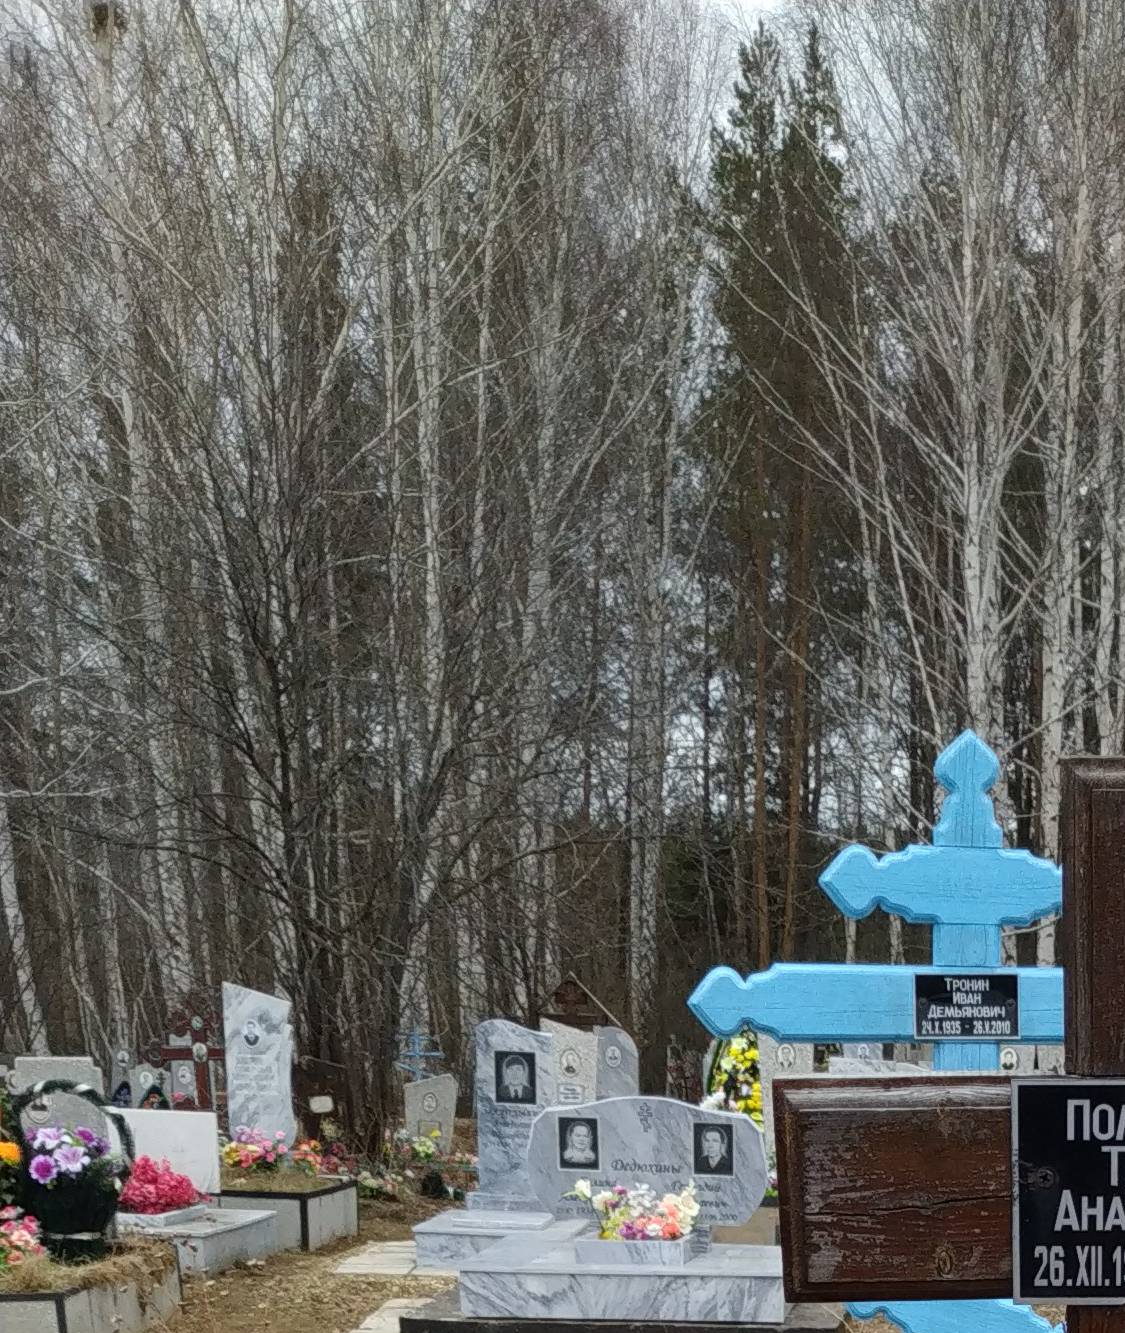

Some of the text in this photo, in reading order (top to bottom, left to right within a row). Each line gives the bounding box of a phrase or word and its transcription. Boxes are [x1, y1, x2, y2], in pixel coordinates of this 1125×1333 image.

[944, 978, 990, 992] ТРОНИН
[952, 992, 982, 1005] ИВАН
[927, 1005, 1006, 1019] ДЕМЬЯНОВИЧ
